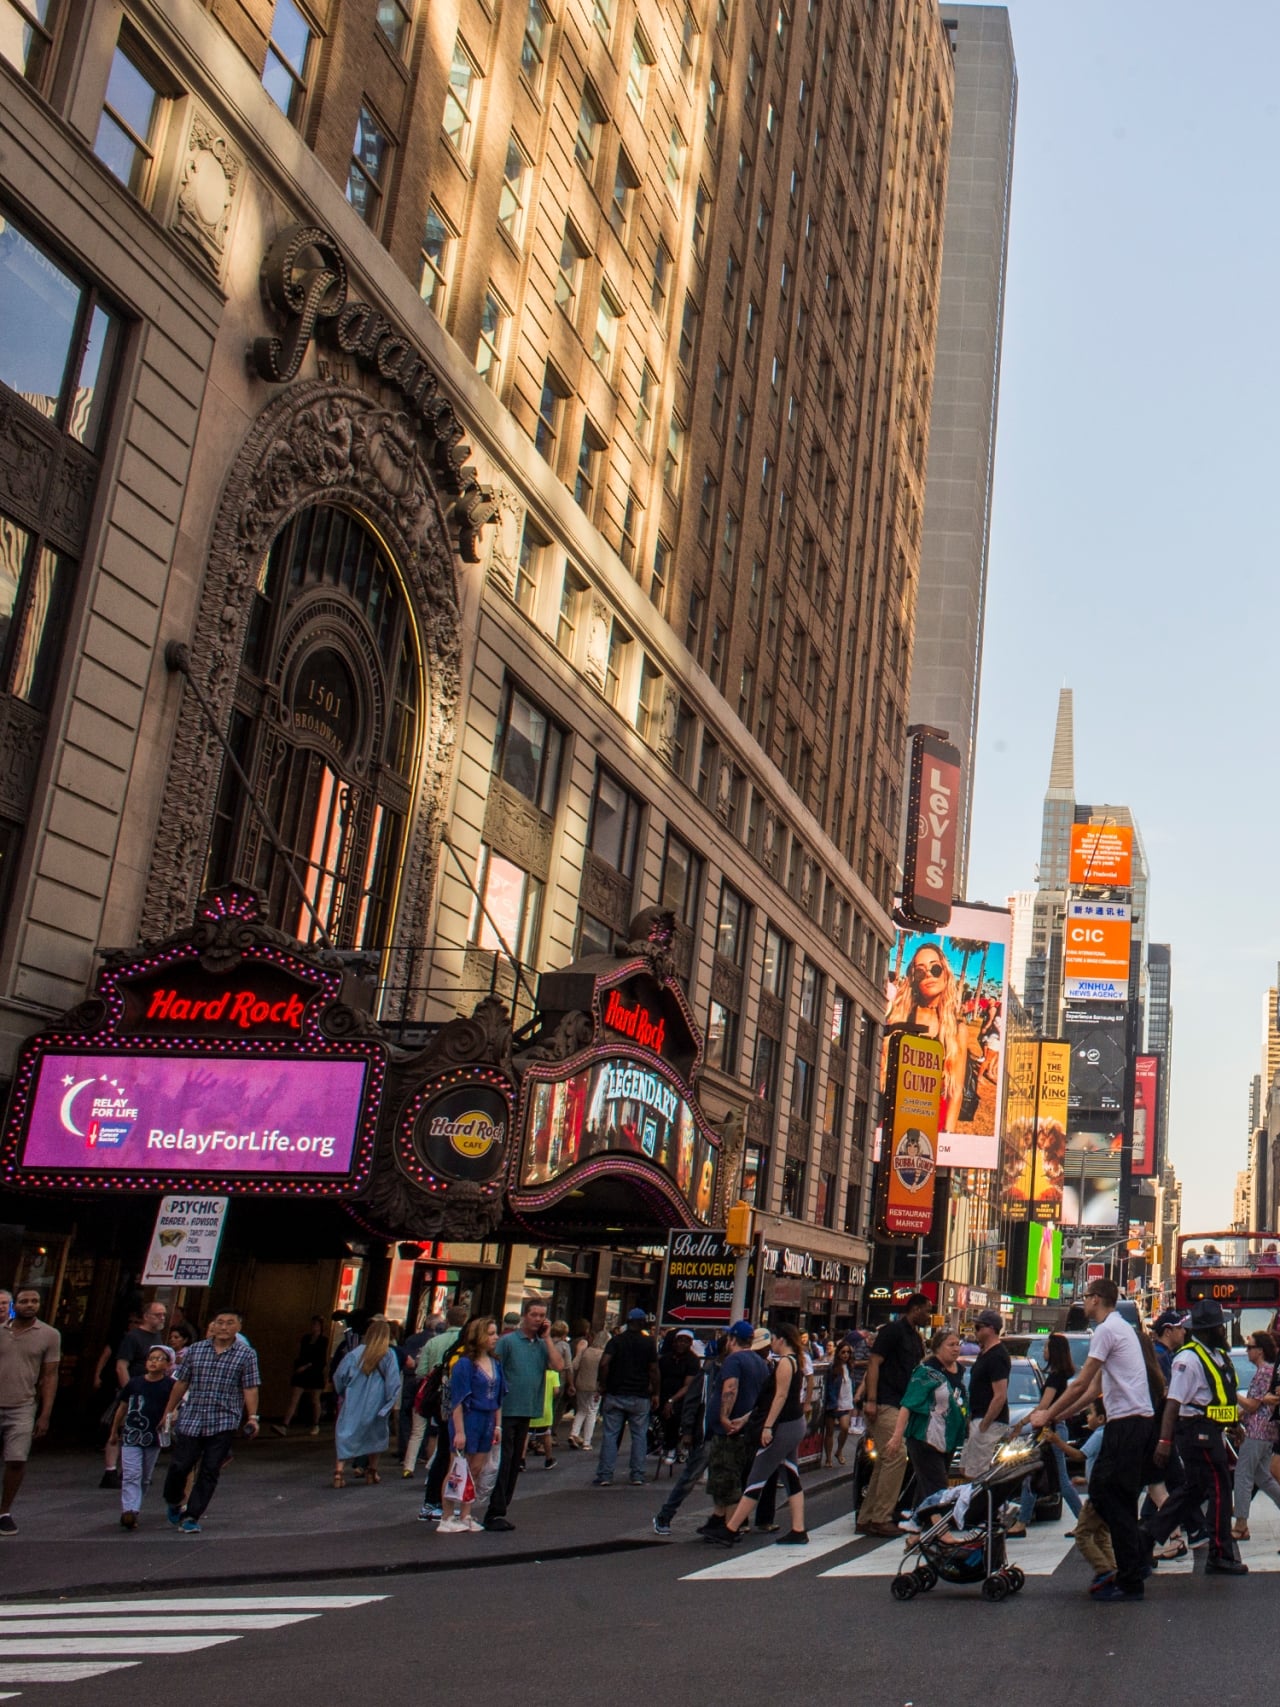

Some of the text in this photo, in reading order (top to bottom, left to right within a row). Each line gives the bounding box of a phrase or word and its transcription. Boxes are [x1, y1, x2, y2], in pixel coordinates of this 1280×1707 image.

[308, 679, 342, 719] 1501
[294, 711, 344, 751] BROADWAY
[1071, 928, 1104, 942] CIC
[1078, 982, 1115, 991] XINHUA
[146, 990, 305, 1028] Hard Rock
[606, 989, 666, 1055] Hard Rock
[901, 1044, 941, 1071] BUBBA
[1047, 1063, 1061, 1071] THE
[903, 1070, 937, 1094] GUMP
[605, 1064, 678, 1124] LEGENDARY
[1041, 1085, 1067, 1100] KING
[93, 1098, 128, 1107] RELAY
[904, 1097, 933, 1107] SHRIMP
[91, 1107, 138, 1118] FOR LIFE
[900, 1105, 937, 1117] COMPANY
[430, 1117, 475, 1137] Hard
[147, 1129, 336, 1157] RelayForLife.org
[894, 1155, 934, 1172] BUBBA GUMP
[170, 1200, 220, 1214] PSYCHIC
[889, 1208, 931, 1218] RESTAURANT
[160, 1216, 219, 1227] READER ADVISOR
[896, 1218, 924, 1229] MARKET
[673, 1233, 718, 1257] Bella
[670, 1261, 698, 1277] BRICK
[700, 1262, 727, 1277] OVEN
[677, 1279, 735, 1291] PASTAS SALA
[685, 1291, 707, 1303] WINE
[1209, 1407, 1233, 1421] TIMES
